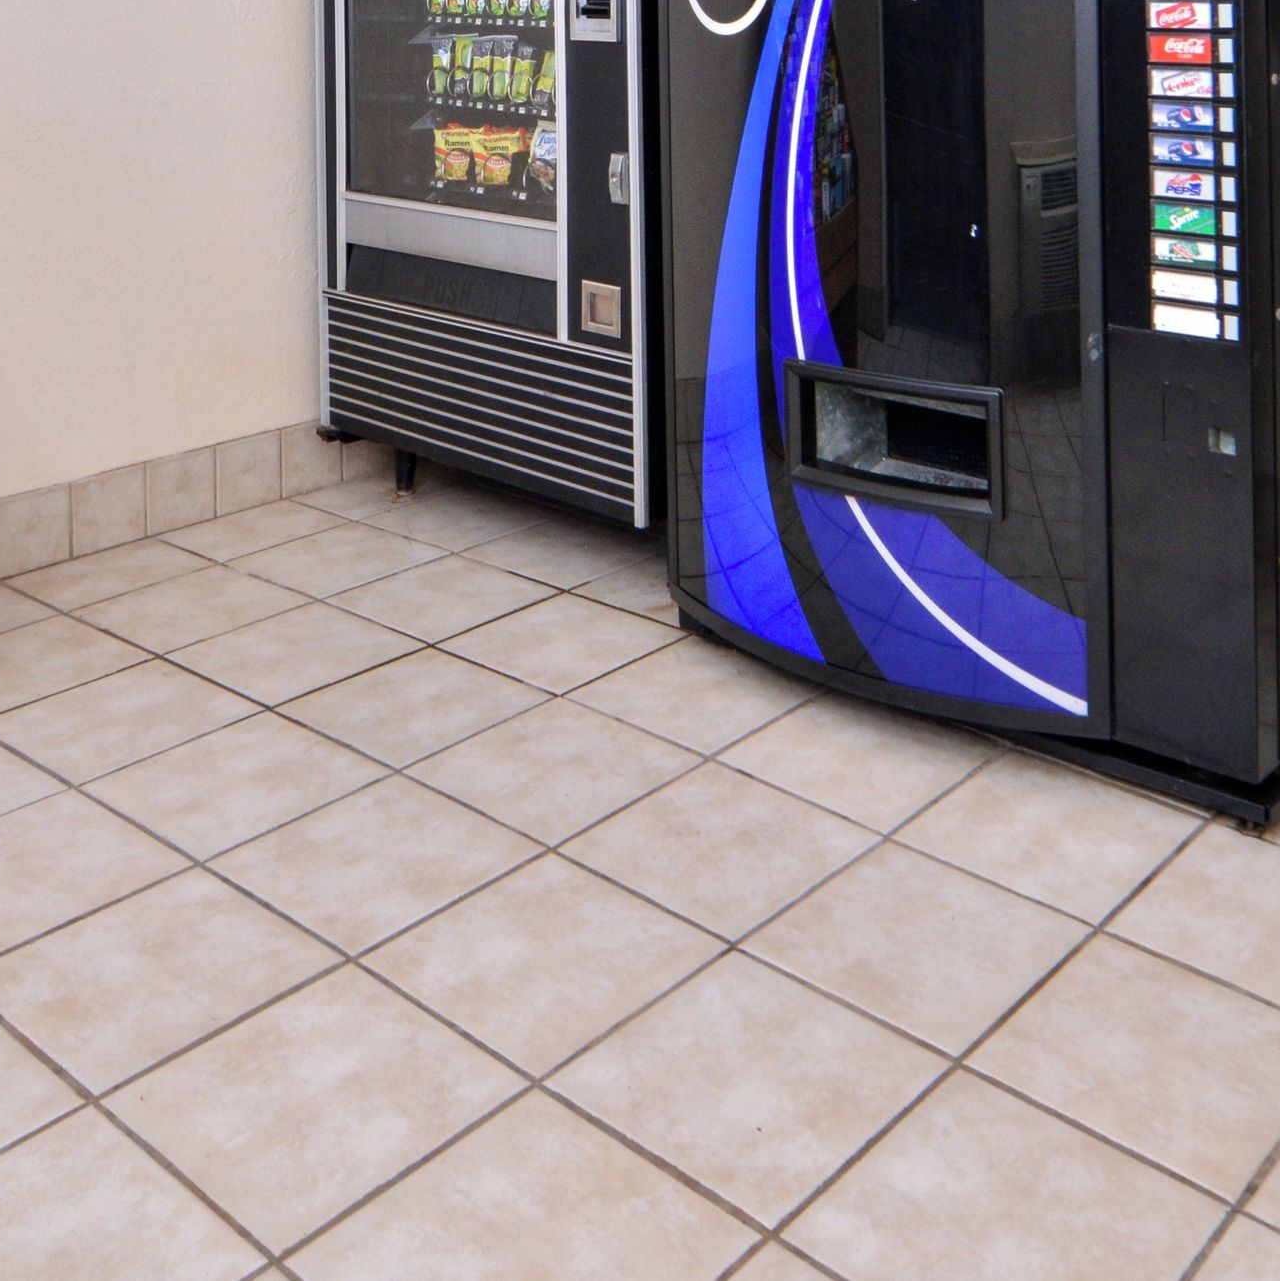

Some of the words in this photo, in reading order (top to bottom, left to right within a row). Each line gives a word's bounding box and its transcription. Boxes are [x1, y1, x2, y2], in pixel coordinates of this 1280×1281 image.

[1164, 37, 1205, 54] Coca-Cola
[444, 140, 471, 148] Ramen
[1166, 184, 1202, 196] PEPSI
[1170, 209, 1200, 230] Sprite
